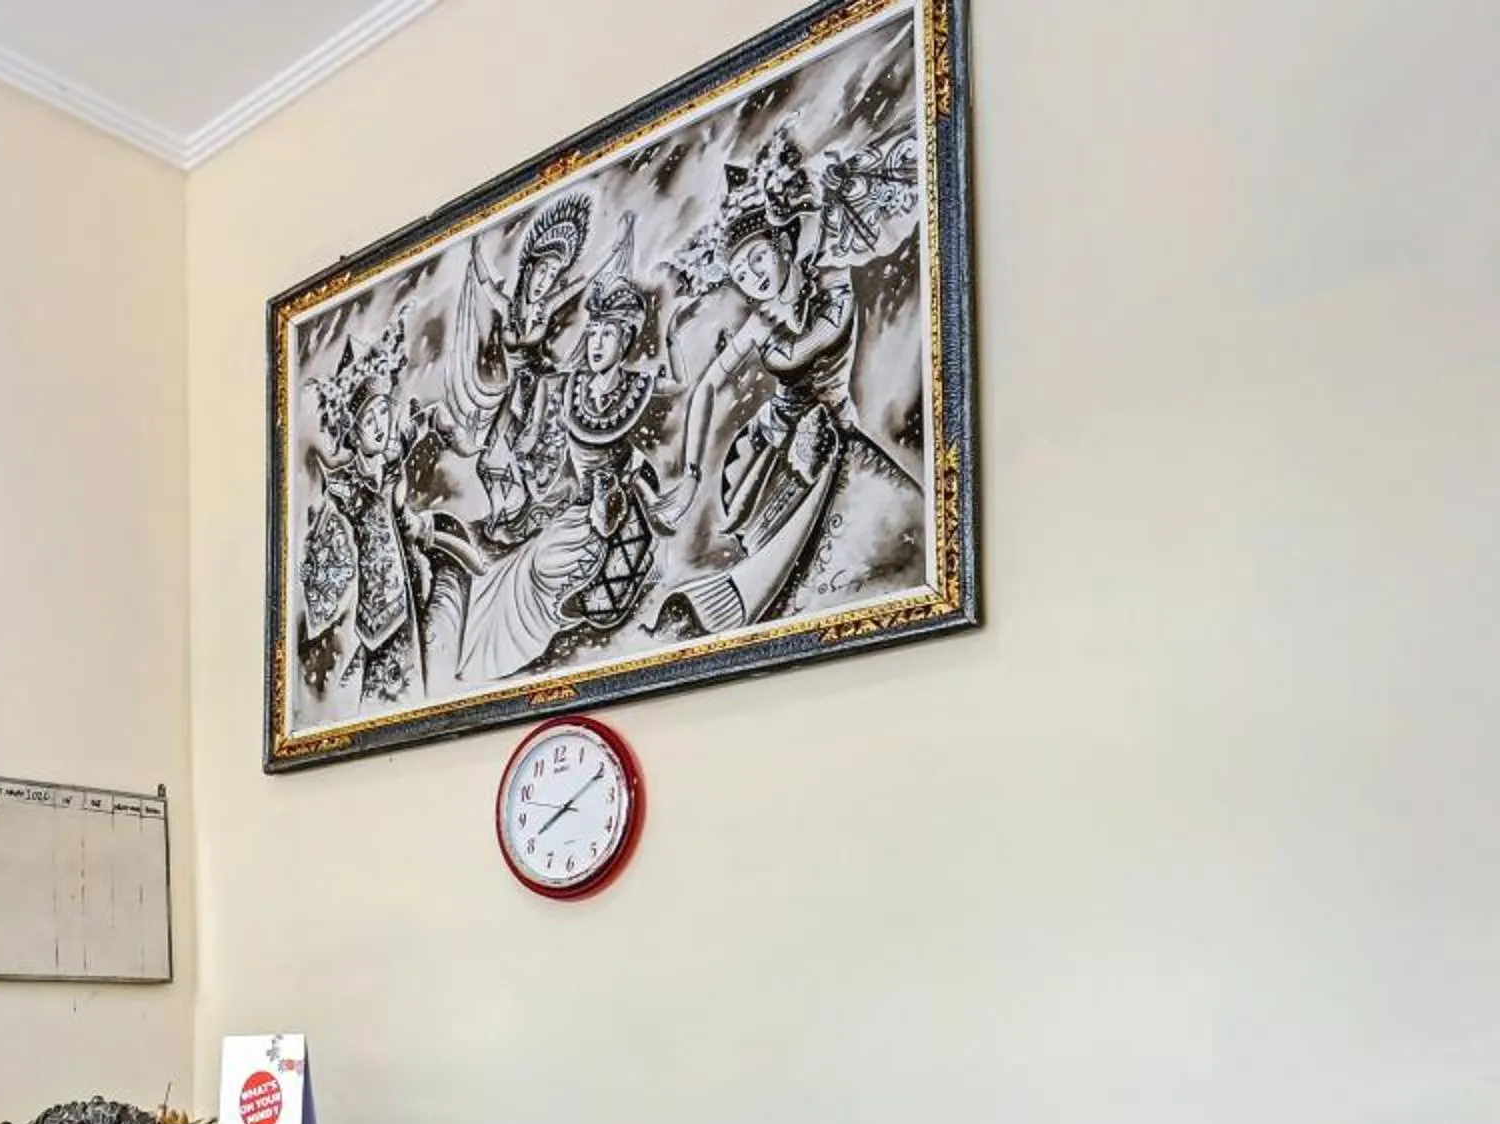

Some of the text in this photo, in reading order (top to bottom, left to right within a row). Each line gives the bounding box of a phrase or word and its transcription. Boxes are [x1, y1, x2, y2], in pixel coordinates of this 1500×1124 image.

[553, 746, 567, 764] 12
[534, 760, 545, 777] 11
[521, 784, 534, 801] 10
